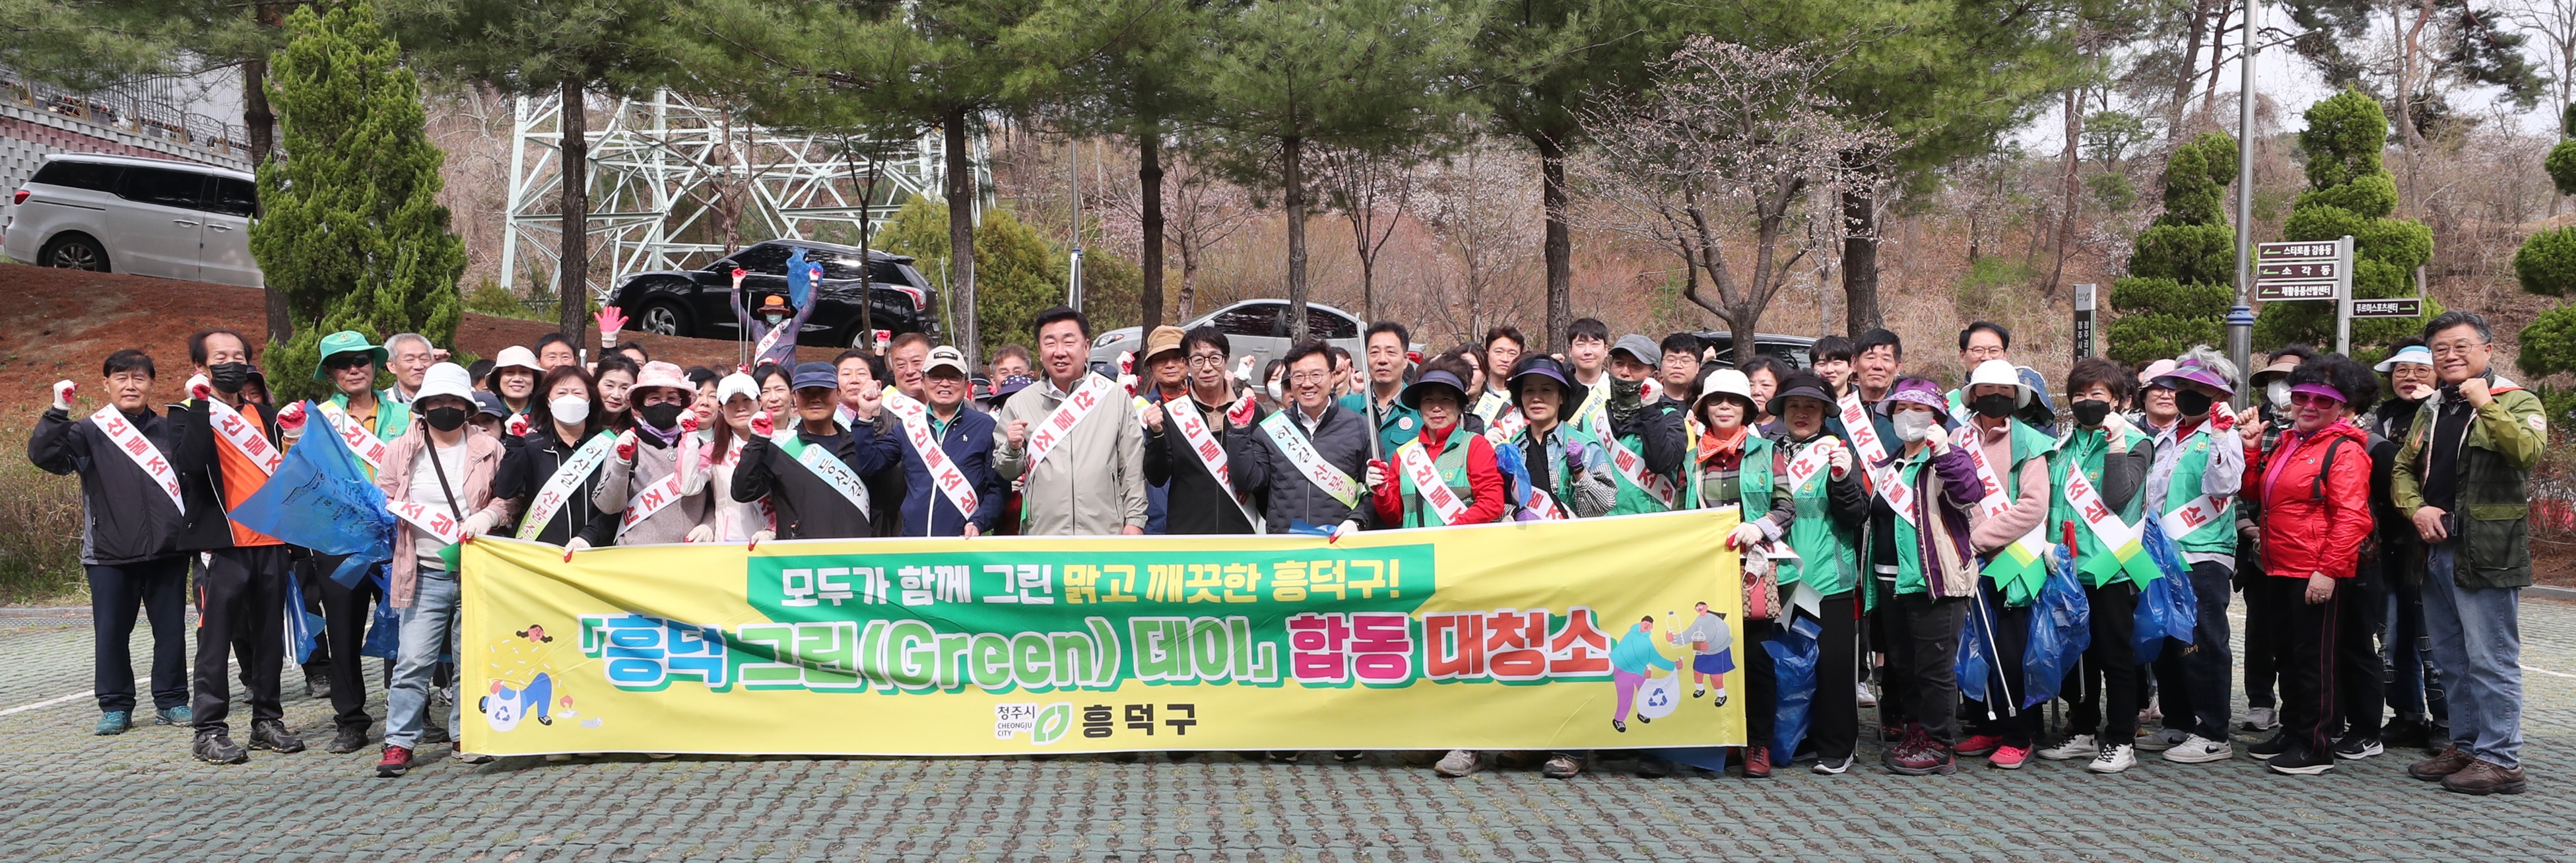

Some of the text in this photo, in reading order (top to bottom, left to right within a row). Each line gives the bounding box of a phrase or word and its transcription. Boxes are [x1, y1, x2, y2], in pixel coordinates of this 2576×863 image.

[2284, 245, 2332, 256] 스티로폼 감용동
[2282, 285, 2330, 296] 재활용품선별센터
[2356, 303, 2398, 314] 푸르미스포츠센터
[106, 417, 180, 498] 산불조심
[1274, 425, 1313, 464] 하산길
[560, 444, 603, 489] 하산길
[818, 458, 865, 497] 등산길
[914, 427, 977, 514] 산불조심
[781, 558, 1400, 606] 모두가 함께 그린 맑고 깨끗한 흥덕구!
[737, 616, 1121, 690] 그린(Green)
[1286, 611, 1413, 684] 합동
[1420, 605, 1614, 681] 대청소
[997, 706, 1036, 720] 청주시
[1082, 703, 1197, 738] 흥덕구
